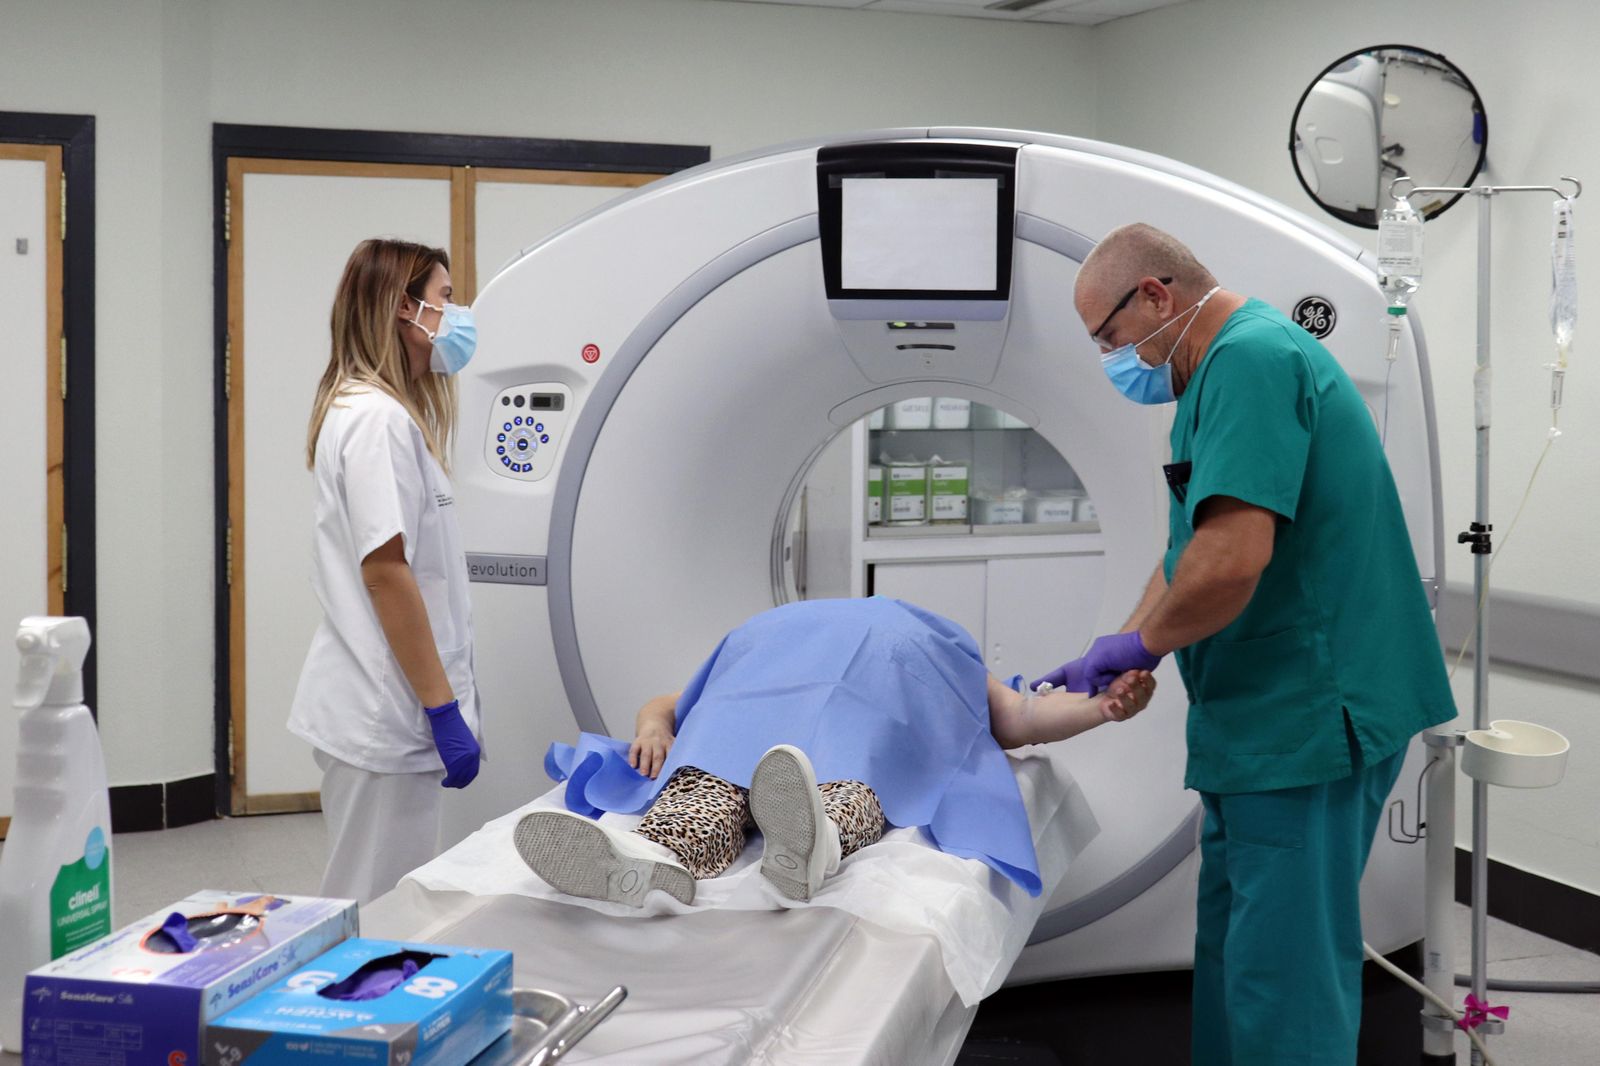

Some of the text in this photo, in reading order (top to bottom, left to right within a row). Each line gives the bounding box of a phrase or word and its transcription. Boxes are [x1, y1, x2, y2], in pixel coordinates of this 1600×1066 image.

[467, 562, 537, 578] evolution
[68, 883, 100, 910] clinell
[228, 962, 279, 999] SensiCare
[60, 990, 115, 1004] SensiCare
